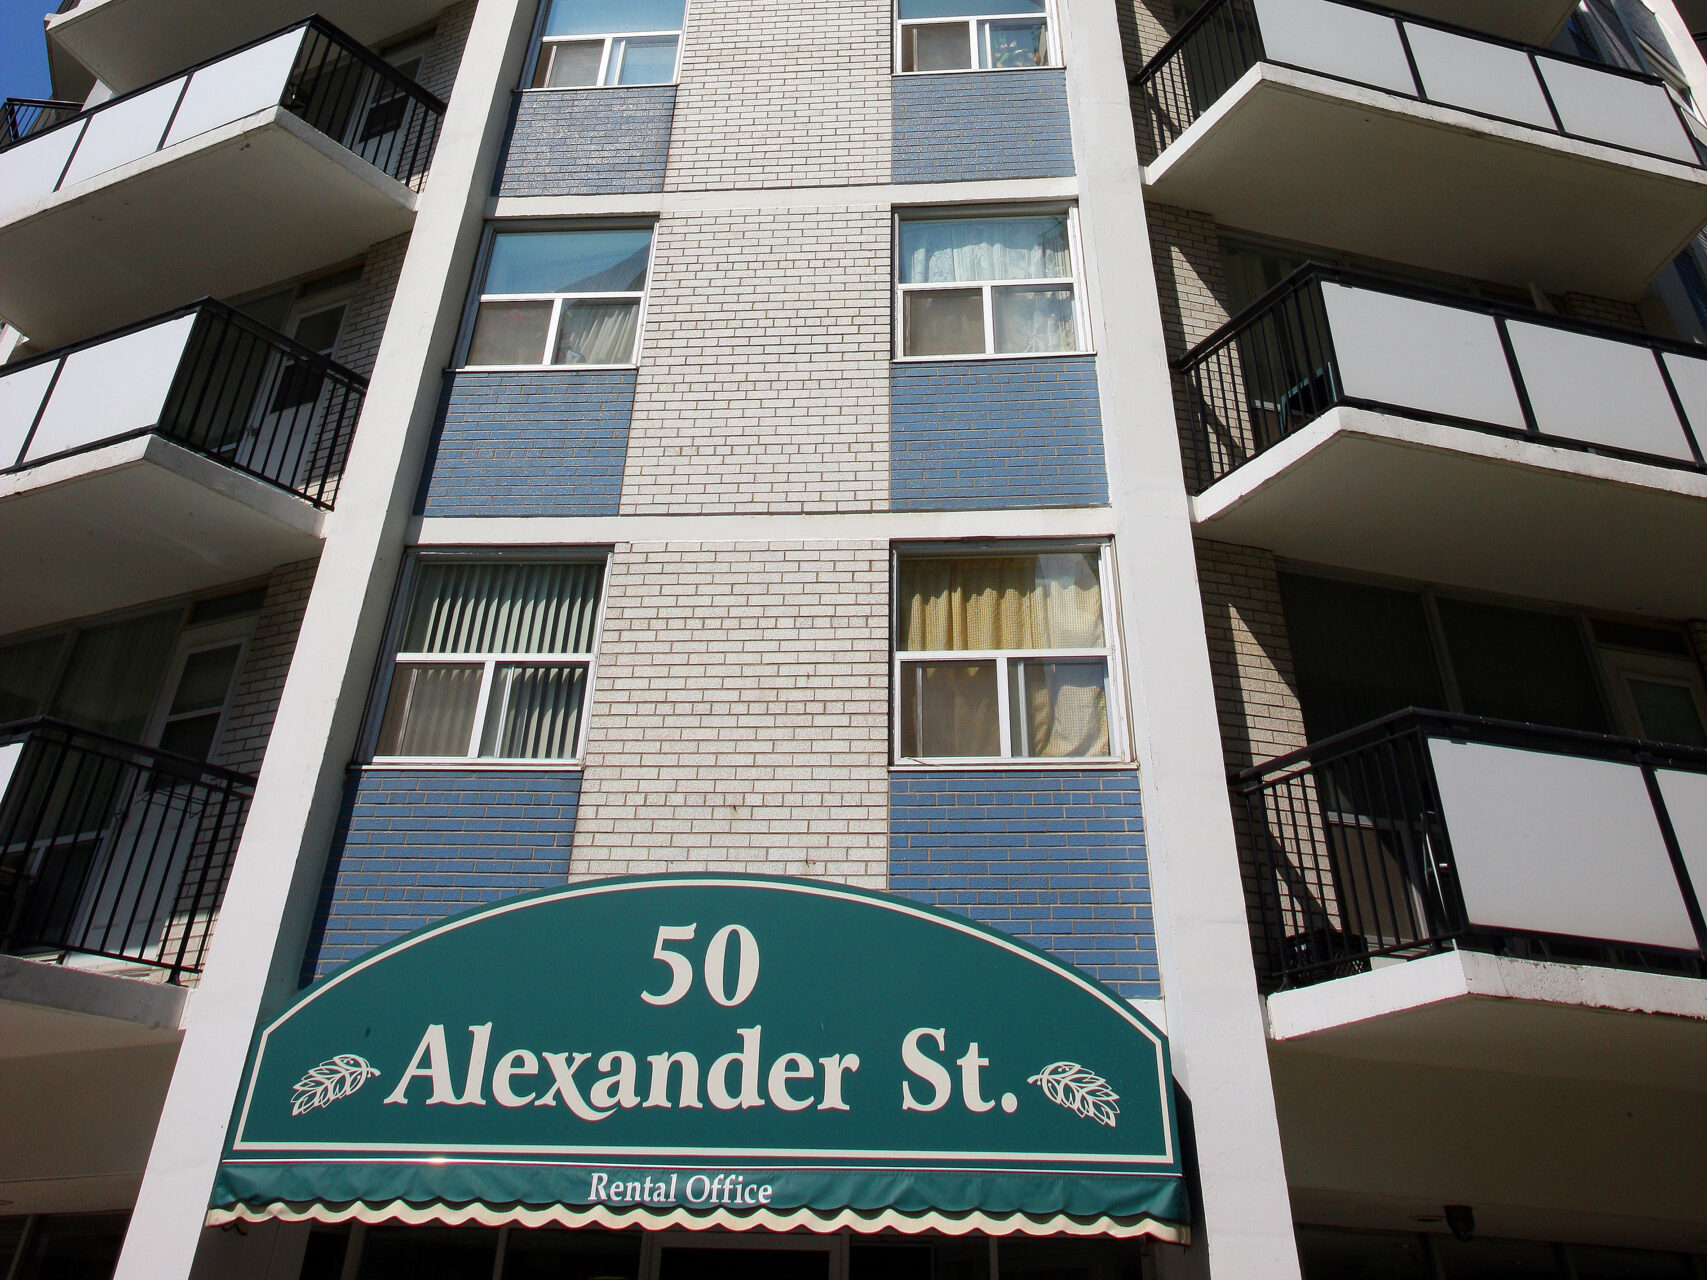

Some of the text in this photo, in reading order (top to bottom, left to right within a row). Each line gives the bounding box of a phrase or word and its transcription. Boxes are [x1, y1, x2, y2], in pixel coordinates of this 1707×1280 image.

[641, 923, 759, 1006] 50
[384, 1022, 1017, 1121] Alexander St.
[588, 1172, 773, 1204] Rental Office
